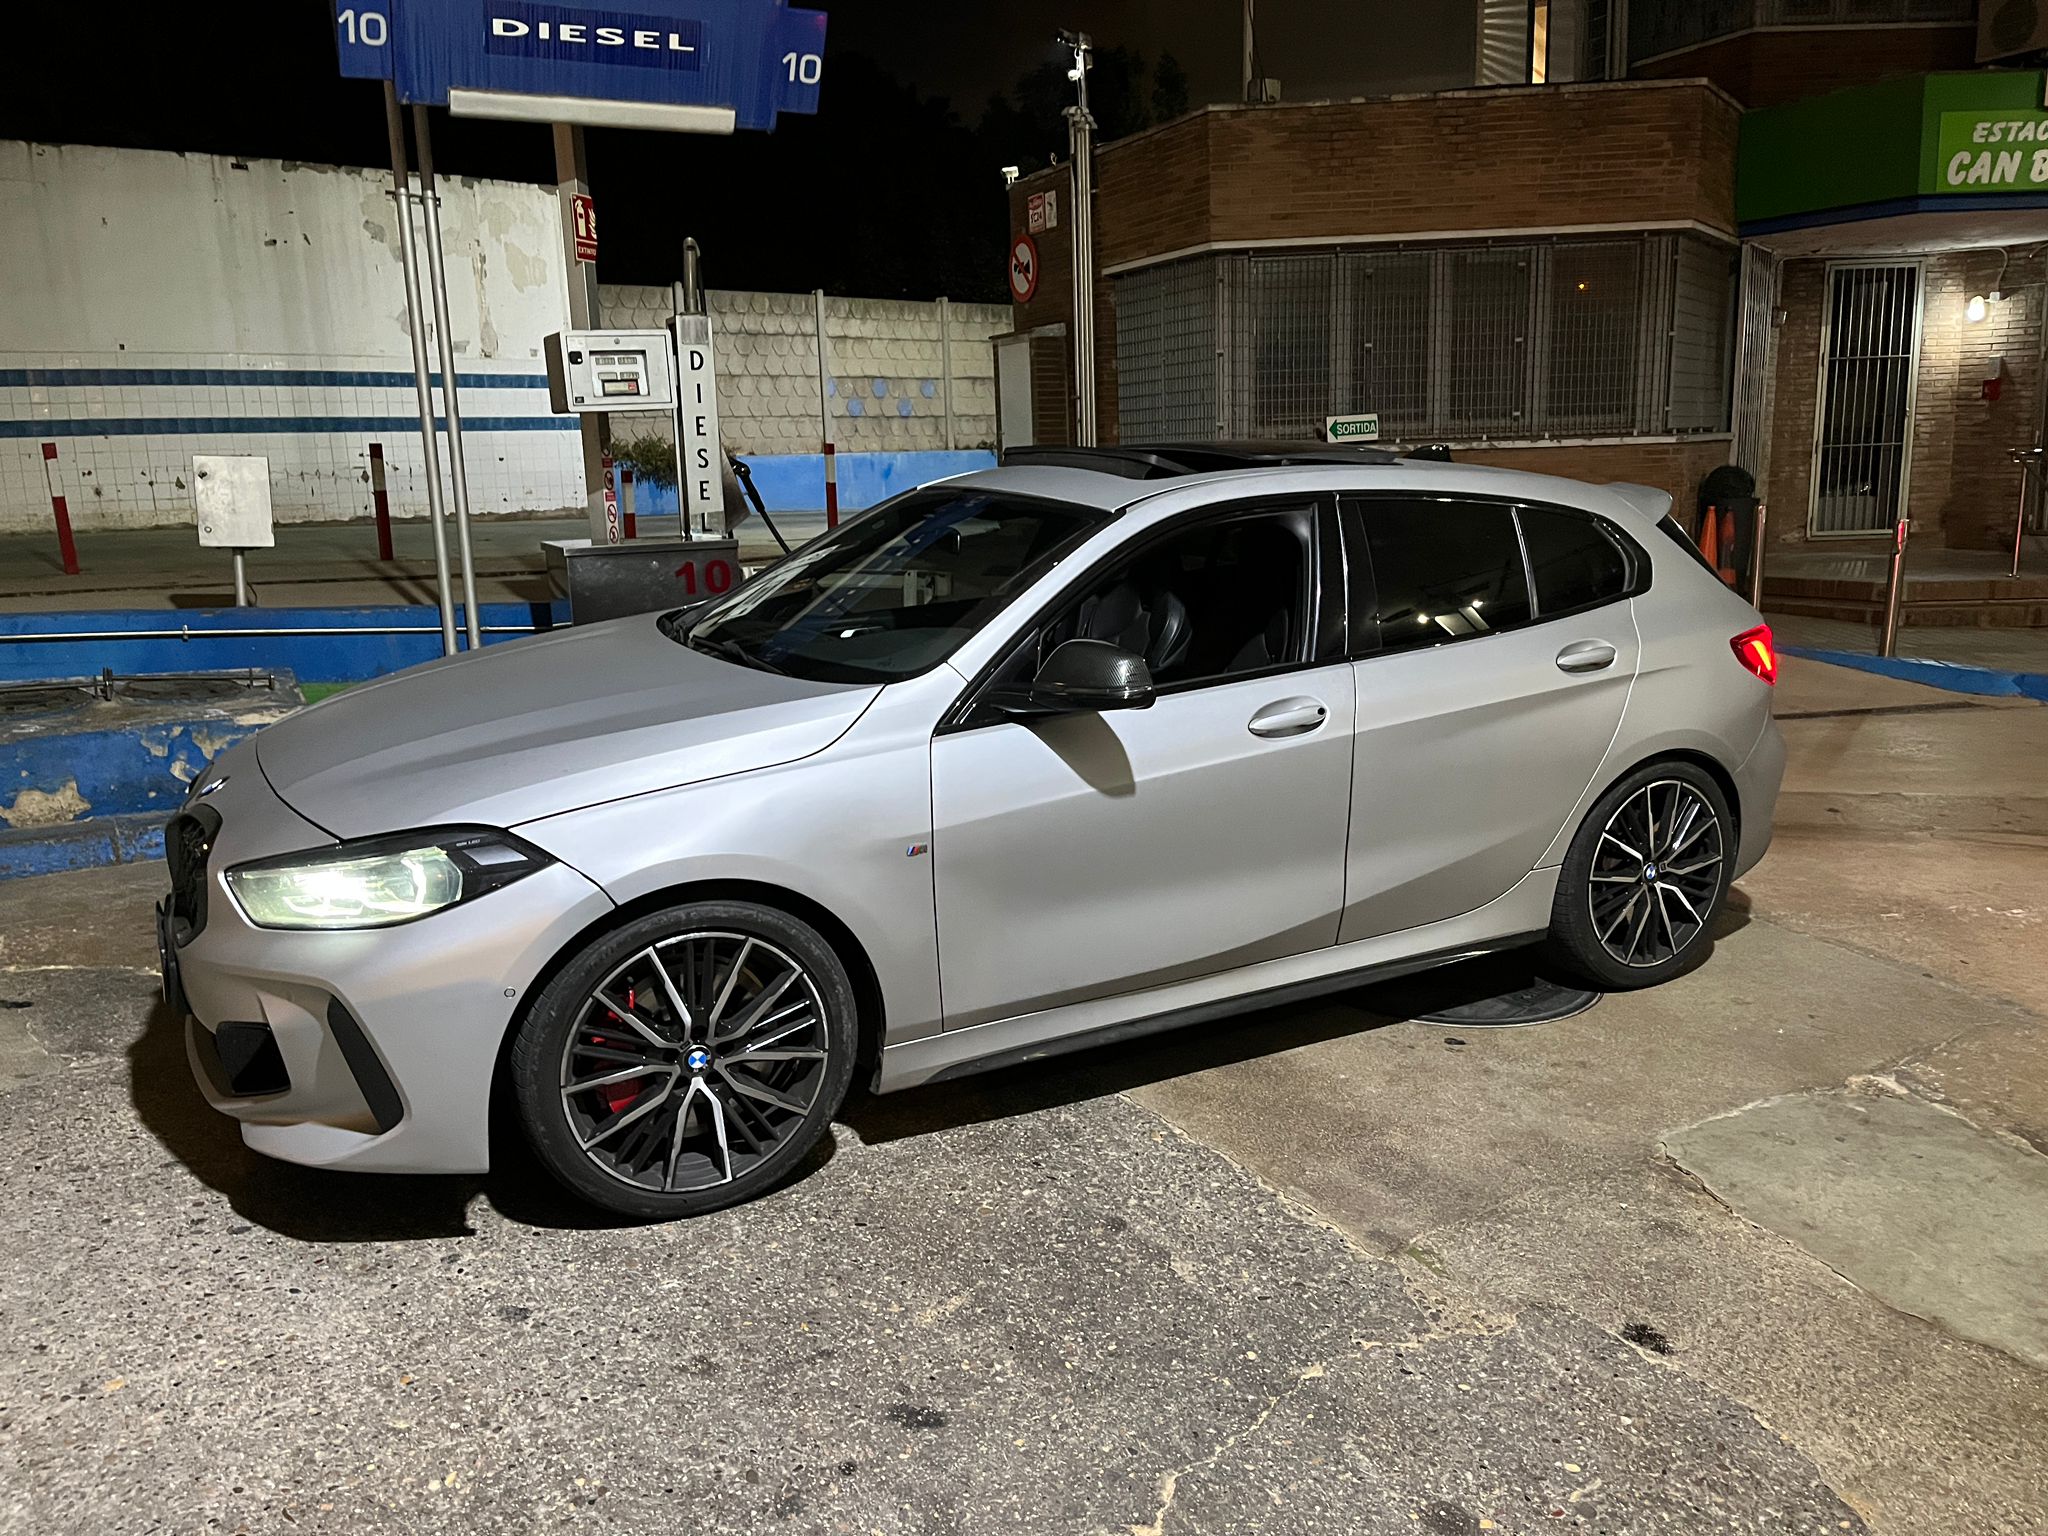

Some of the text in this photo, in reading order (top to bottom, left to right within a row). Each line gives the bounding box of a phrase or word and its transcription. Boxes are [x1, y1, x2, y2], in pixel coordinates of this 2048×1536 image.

[338, 9, 388, 47] 10
[491, 17, 695, 52] DIESEL
[782, 52, 822, 85] 10
[1947, 151, 2023, 185] CAN
[689, 350, 713, 532] DIESEL
[1336, 422, 1377, 435] SORTIDA
[675, 560, 732, 596] 10
